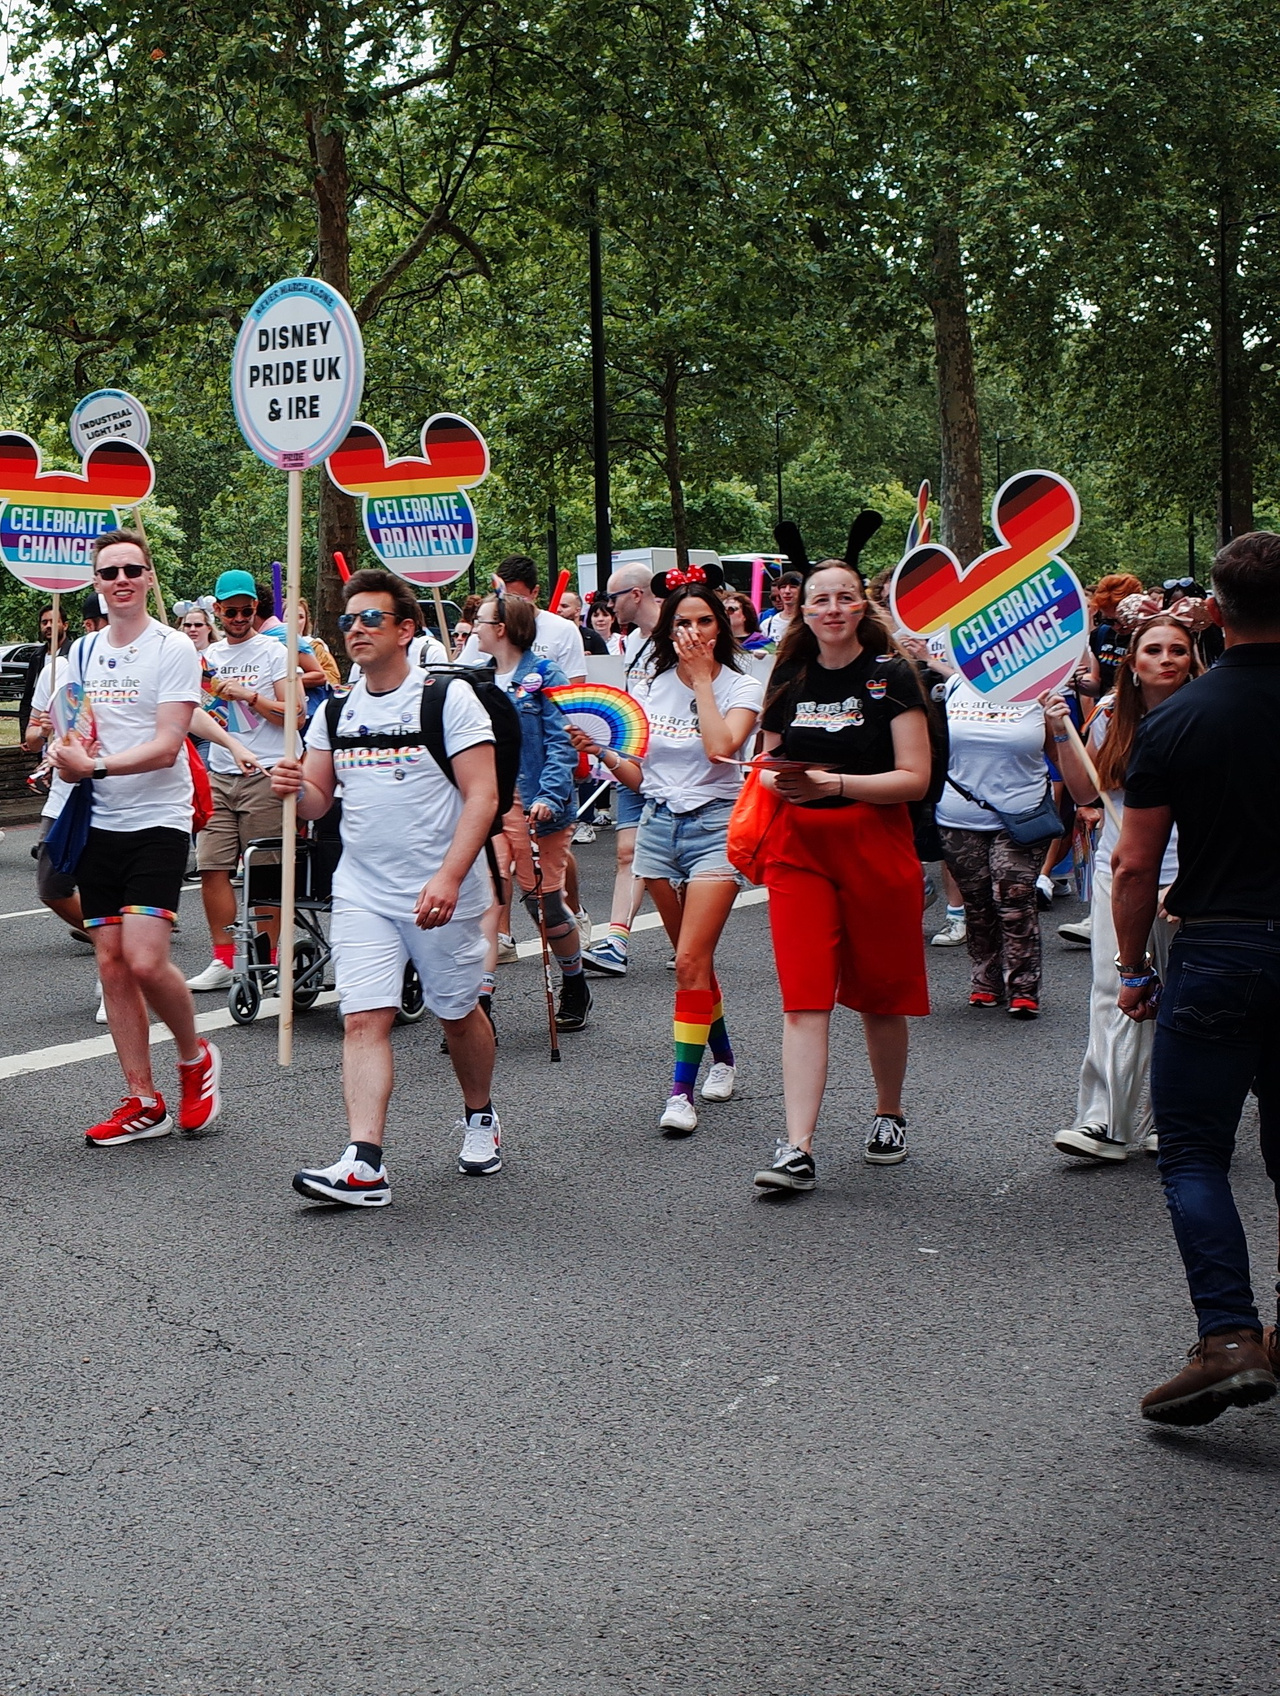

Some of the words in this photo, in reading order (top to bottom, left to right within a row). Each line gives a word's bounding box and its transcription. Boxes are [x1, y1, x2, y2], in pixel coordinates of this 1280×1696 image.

[258, 320, 332, 352] DISNEY
[249, 359, 307, 388] PRIDE
[313, 356, 342, 381] UK
[79, 408, 133, 431] INDUSTRIAL
[269, 399, 282, 422] &
[288, 395, 320, 420] IRE
[86, 426, 112, 440] LIGHT
[113, 419, 133, 432] AND
[10, 507, 108, 535] CELEBRATE
[373, 495, 462, 525] CELEBRATE
[379, 523, 465, 558] BRAVERY
[956, 567, 1063, 655] CELEBRATE
[533, 642, 549, 652] he
[981, 605, 1071, 684] CHANGE
[100, 680, 118, 688] are
[121, 676, 141, 688] the
[221, 665, 239, 675] are
[240, 663, 260, 673] the
[972, 701, 997, 710] are
